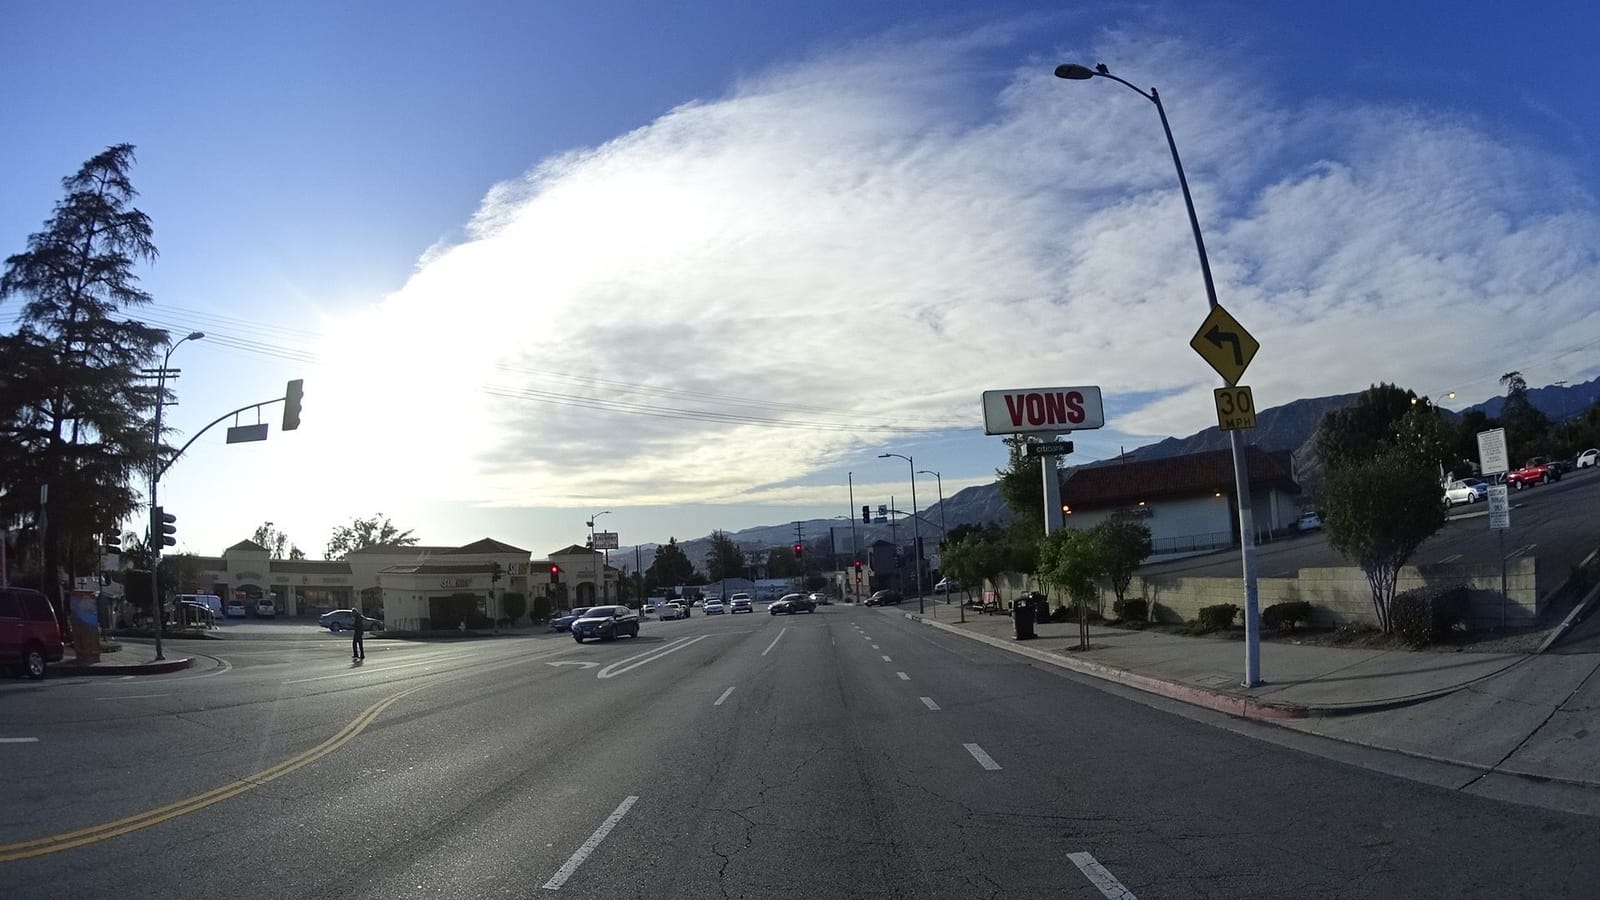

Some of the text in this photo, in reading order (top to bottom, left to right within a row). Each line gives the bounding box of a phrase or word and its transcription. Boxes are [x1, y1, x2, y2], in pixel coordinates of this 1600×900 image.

[1004, 392, 1085, 426] VONS
[1219, 391, 1251, 415] 30
[1226, 417, 1251, 428] MPH
[1036, 445, 1064, 453] citibank
